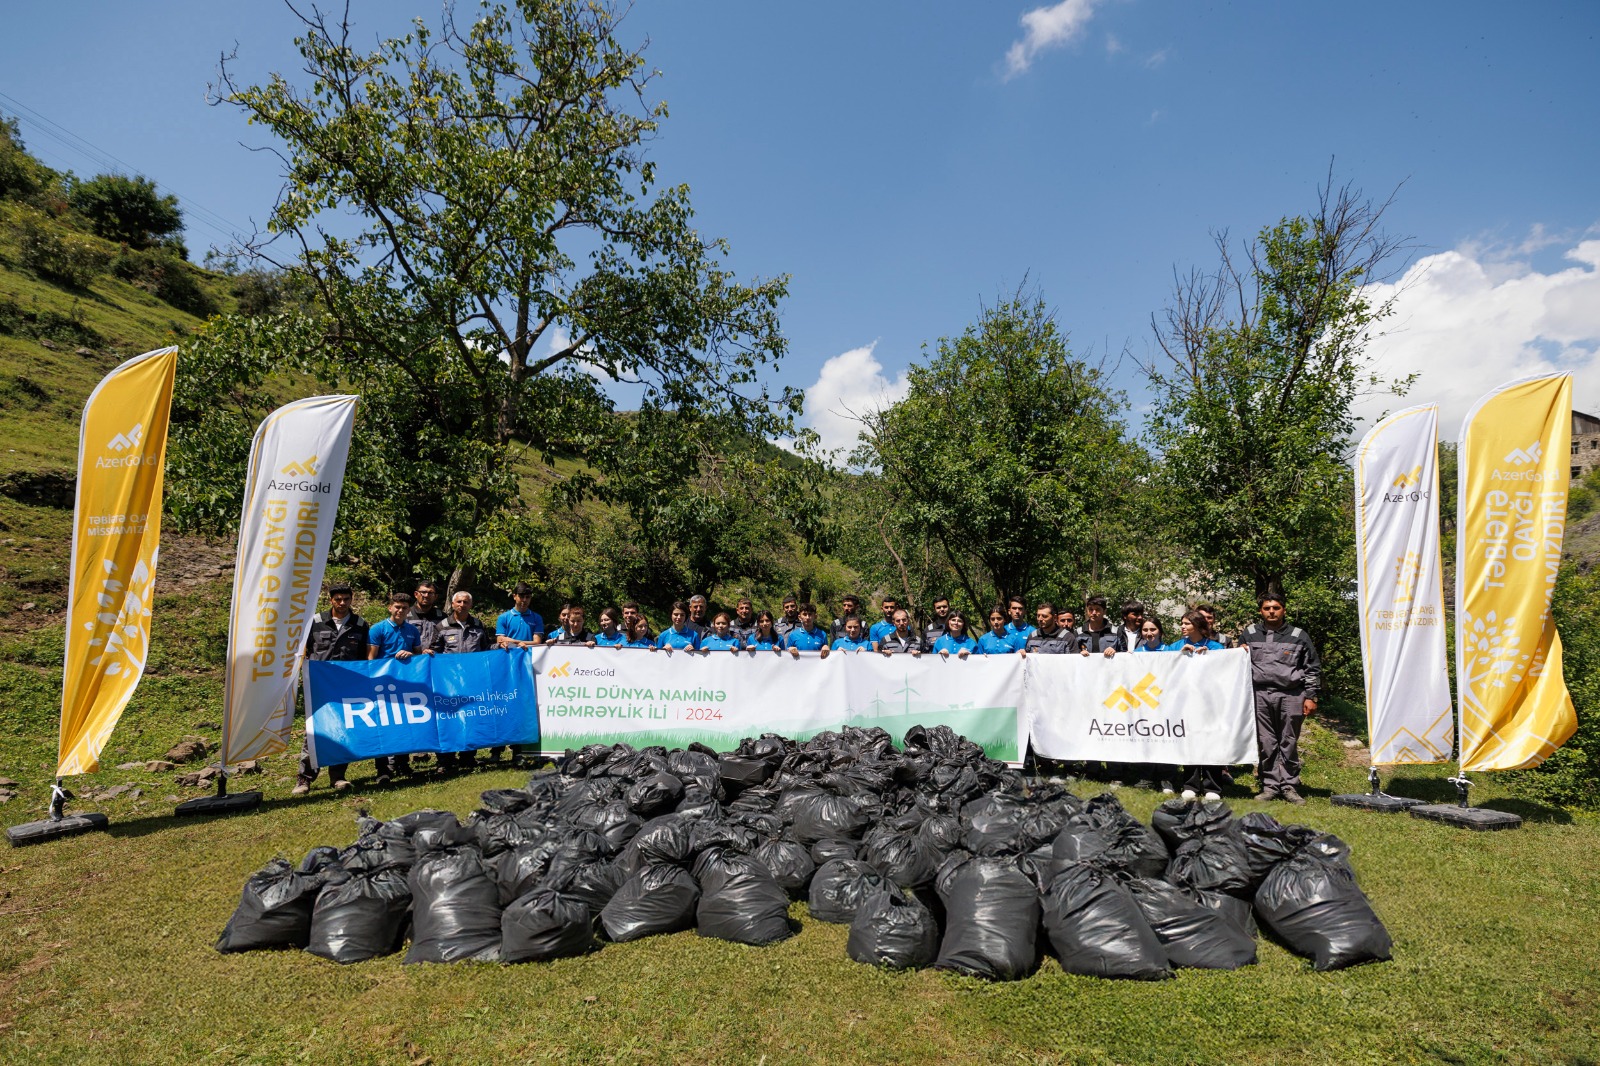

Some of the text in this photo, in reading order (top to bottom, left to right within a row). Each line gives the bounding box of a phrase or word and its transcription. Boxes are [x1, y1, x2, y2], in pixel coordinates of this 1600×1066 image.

[95, 453, 157, 469] AzerGold
[1491, 468, 1560, 482] AzerGold
[267, 479, 331, 494] AzerGold
[1509, 491, 1539, 561] QAYĞI
[1479, 489, 1509, 592] TƏBİƏTƏ
[251, 500, 288, 682] TƏBİƏTƏ QAYĞI
[282, 501, 320, 679] MİSSİYAMIZDIR!
[573, 667, 615, 677] AzerGold
[434, 688, 518, 707] Regional İnkişaf
[547, 685, 727, 702] YAŞIL DÜNYA NAMİNƏ
[479, 704, 508, 717] Birliyi
[546, 703, 723, 721] HƏMRƏYLİK İLİ 2024
[1088, 718, 1186, 738] AzerGold
